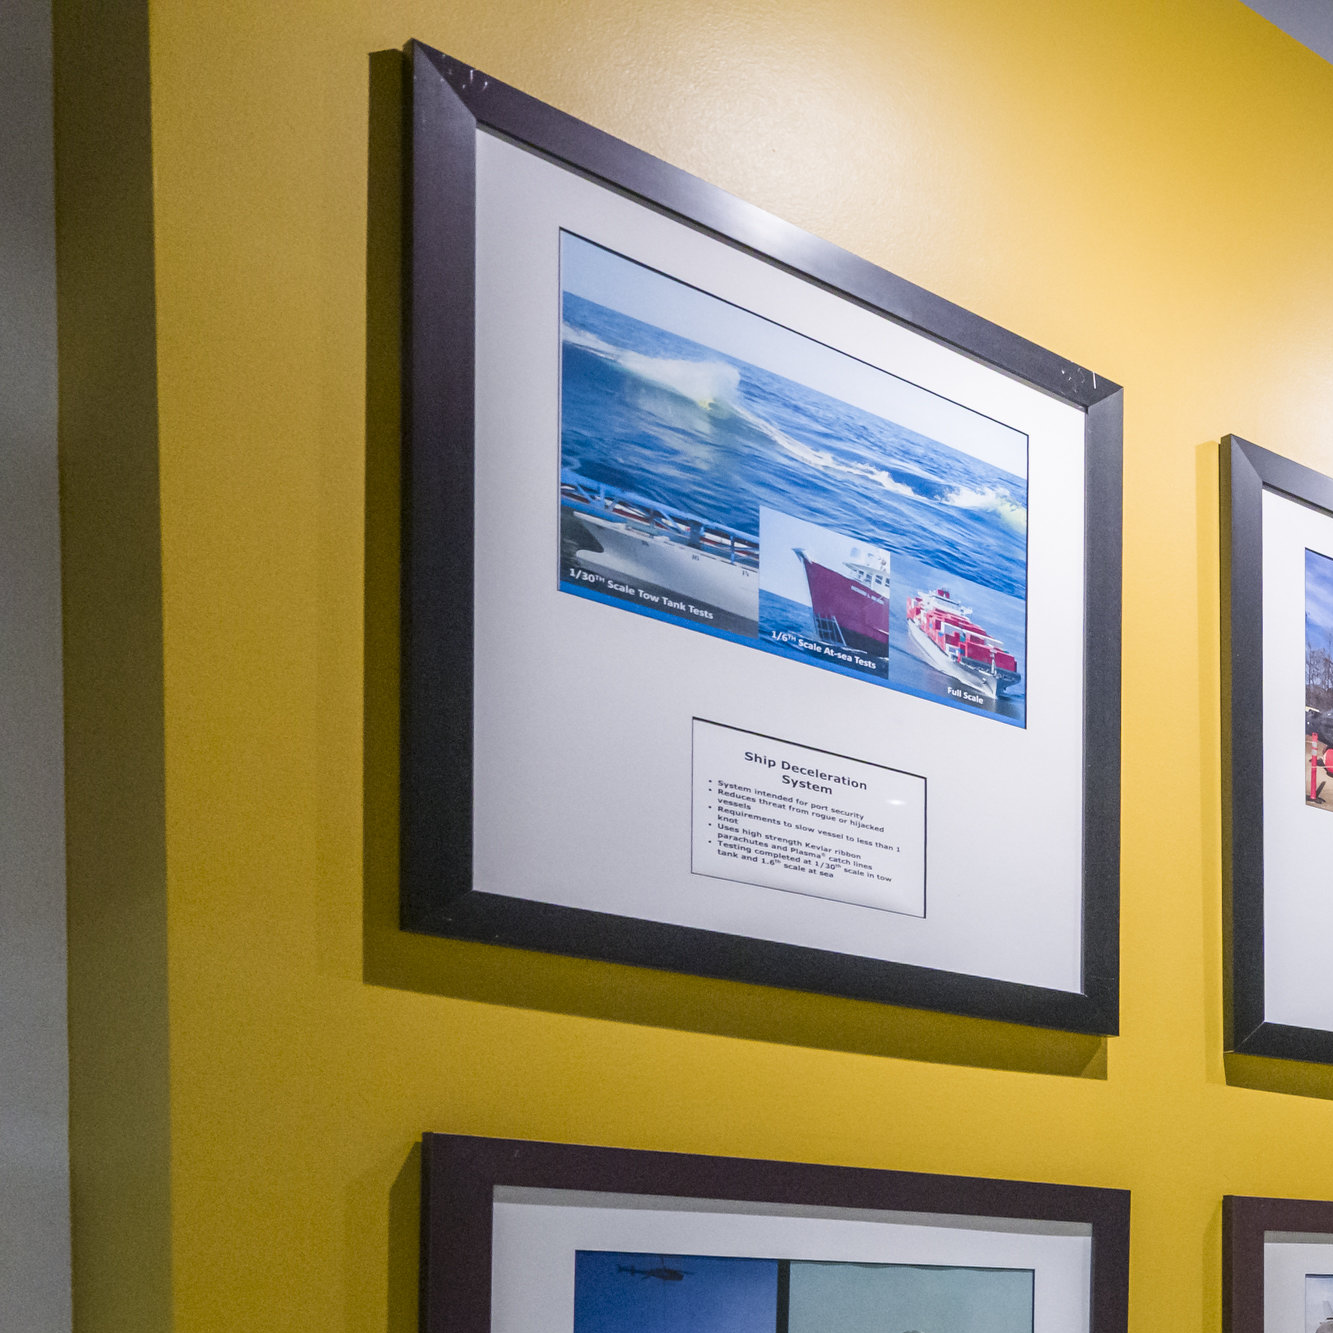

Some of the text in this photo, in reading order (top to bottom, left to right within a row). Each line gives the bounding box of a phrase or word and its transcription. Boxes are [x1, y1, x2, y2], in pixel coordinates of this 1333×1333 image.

[608, 580, 635, 595] Scale
[638, 589, 659, 602] Tow
[662, 597, 686, 611] Tank
[688, 605, 713, 619] Tests
[798, 639, 822, 652] Scale
[824, 647, 852, 662] At-sea
[854, 656, 876, 669] Tests
[948, 687, 983, 704] Full Scale
[745, 752, 867, 790] Ship Deceleration
[782, 775, 832, 794] System
[718, 780, 751, 793] System
[755, 789, 793, 803] intended
[831, 808, 864, 821] security
[718, 799, 751, 810] vessels
[718, 789, 756, 802] Reduces
[759, 799, 785, 809] threat
[789, 805, 809, 815] from
[812, 812, 836, 821] rogue
[850, 820, 884, 832] hijacked
[718, 814, 738, 824] knot
[718, 806, 780, 825] Requirements
[818, 830, 843, 839] vessel
[857, 838, 872, 846] less
[875, 842, 893, 850] than
[718, 823, 861, 859] Uses high strength Kevlar ribbon
[718, 833, 768, 847] parachutes
[829, 857, 850, 865] catch
[854, 861, 872, 870] lines
[718, 840, 751, 853] Testing
[755, 849, 800, 863] completed
[844, 868, 864, 876] scale
[718, 849, 738, 858] tank
[784, 864, 805, 872] scale
